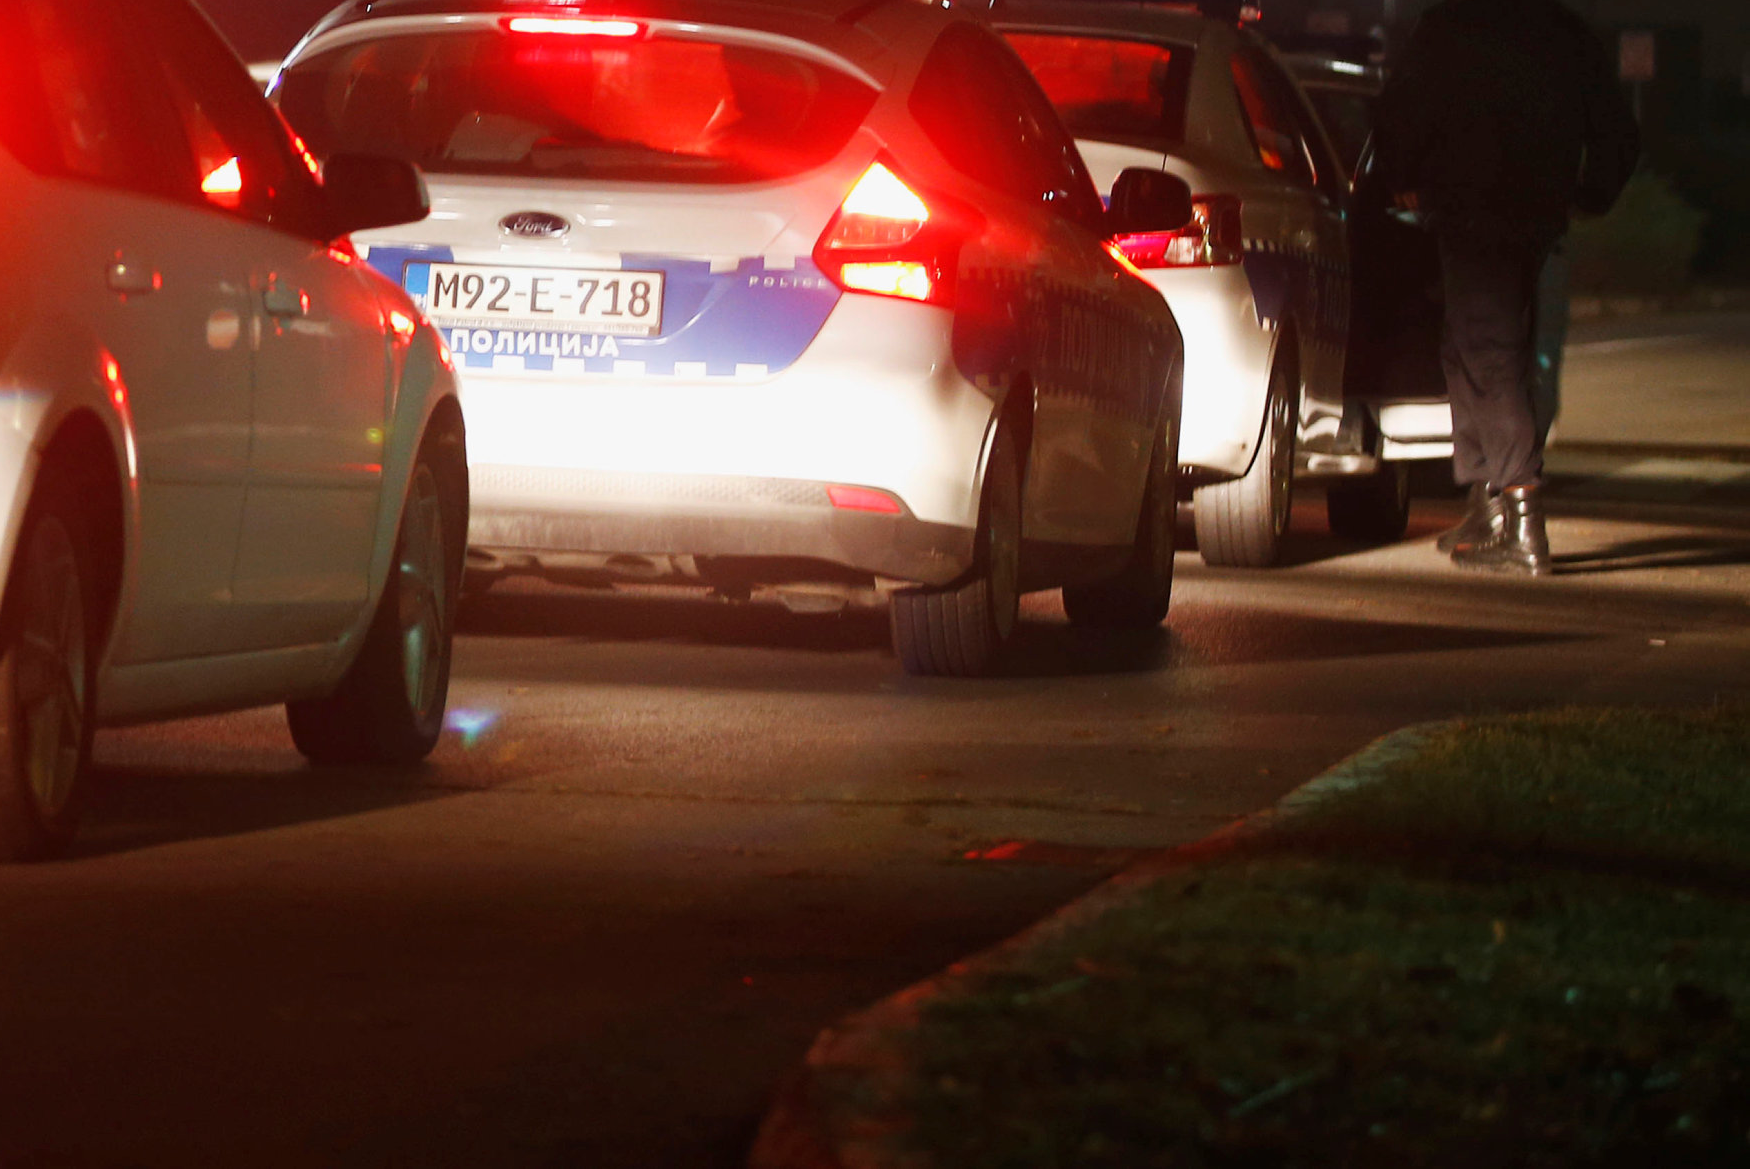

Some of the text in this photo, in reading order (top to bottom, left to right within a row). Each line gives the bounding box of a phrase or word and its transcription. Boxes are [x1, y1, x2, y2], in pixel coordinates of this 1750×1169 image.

[433, 271, 651, 318] M92-E-718
[749, 275, 828, 290] POLICE
[450, 328, 620, 359] ПОЛИЦИЈА
